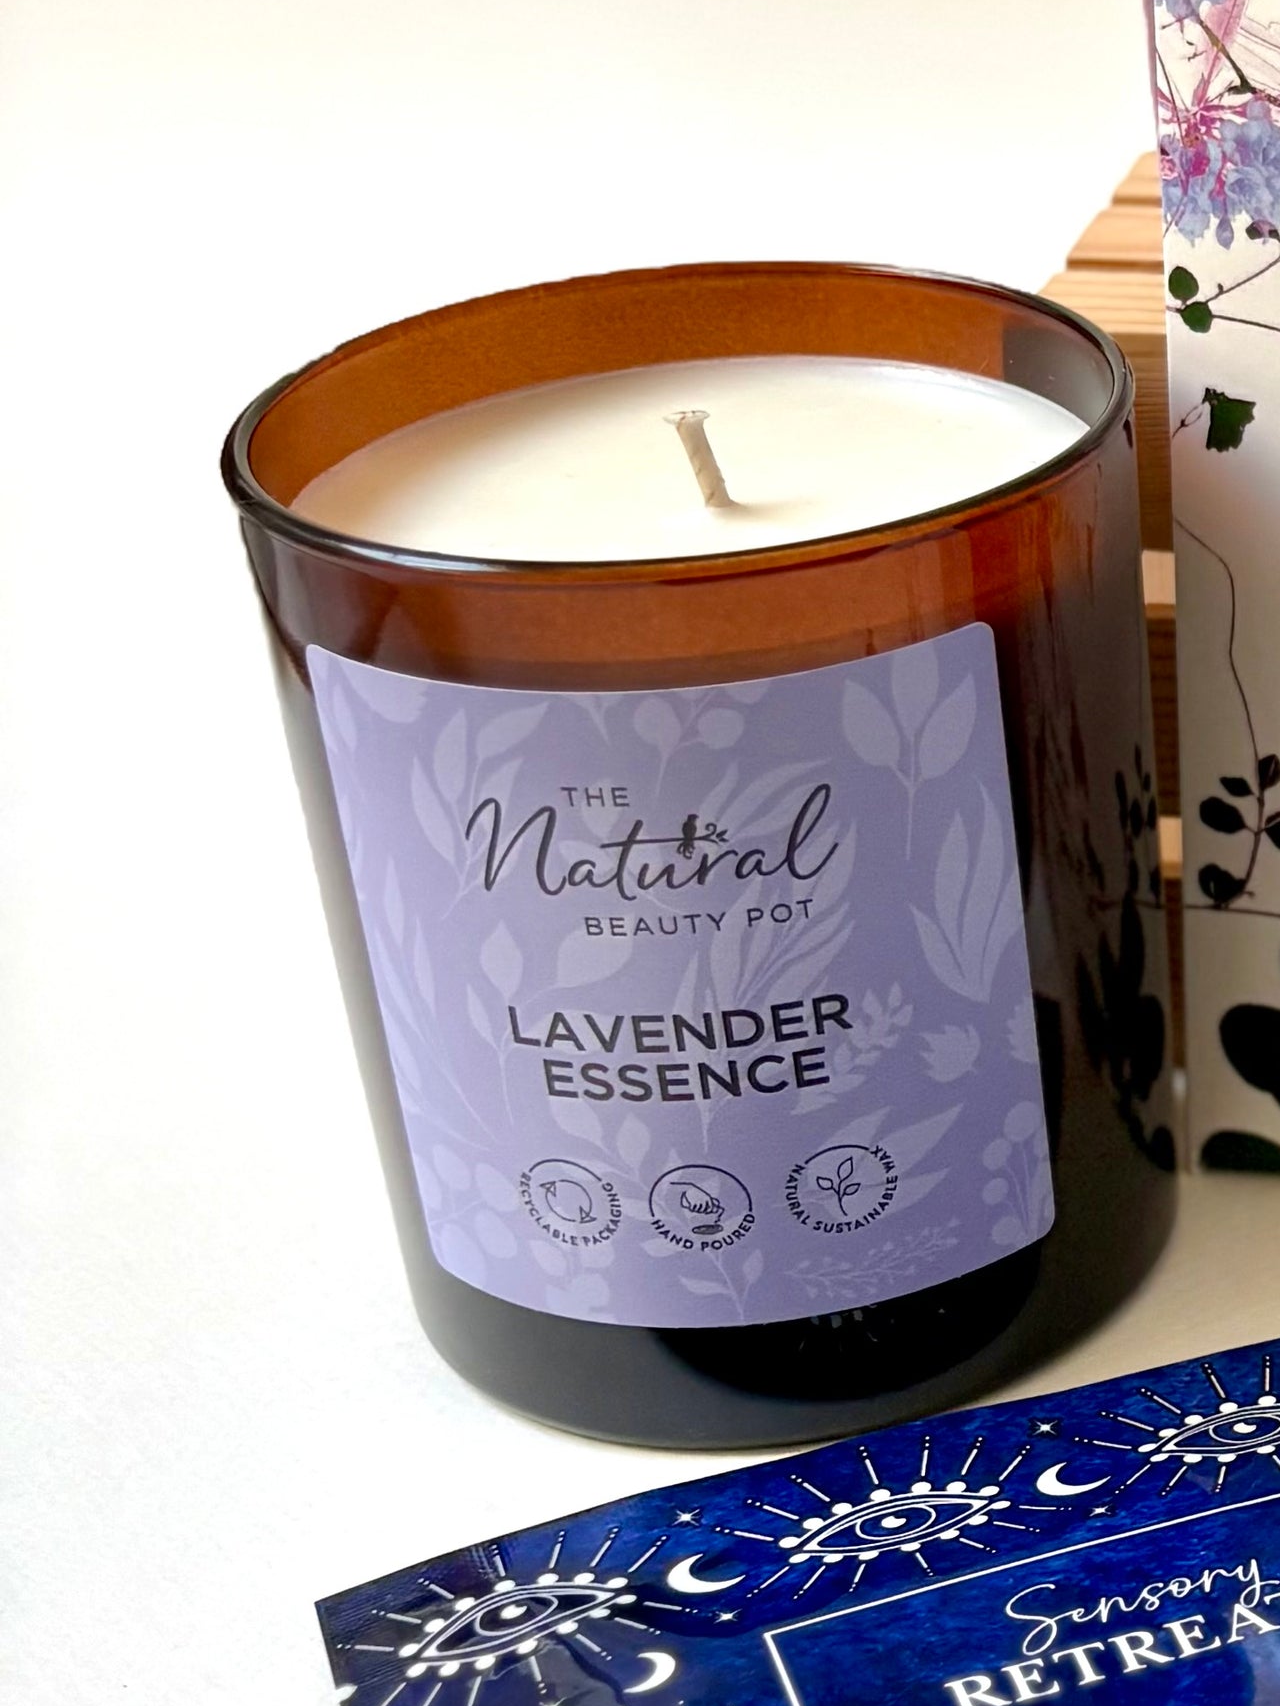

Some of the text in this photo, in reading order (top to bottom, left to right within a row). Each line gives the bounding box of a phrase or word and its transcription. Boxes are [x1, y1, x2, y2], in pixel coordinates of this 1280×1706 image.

[559, 786, 631, 808] THE
[465, 782, 840, 901] Natural
[583, 898, 815, 937] BEAUTY POT
[507, 993, 855, 1055] LAVENDER
[542, 1046, 831, 1103] ESSENCE
[519, 1172, 622, 1247] RECYCLABLE PACKAGING
[785, 1144, 898, 1234] NATURAL SUSTAINABLE WAX
[650, 1213, 756, 1252] HAND POURED
[1004, 1556, 1280, 1656] Sensory
